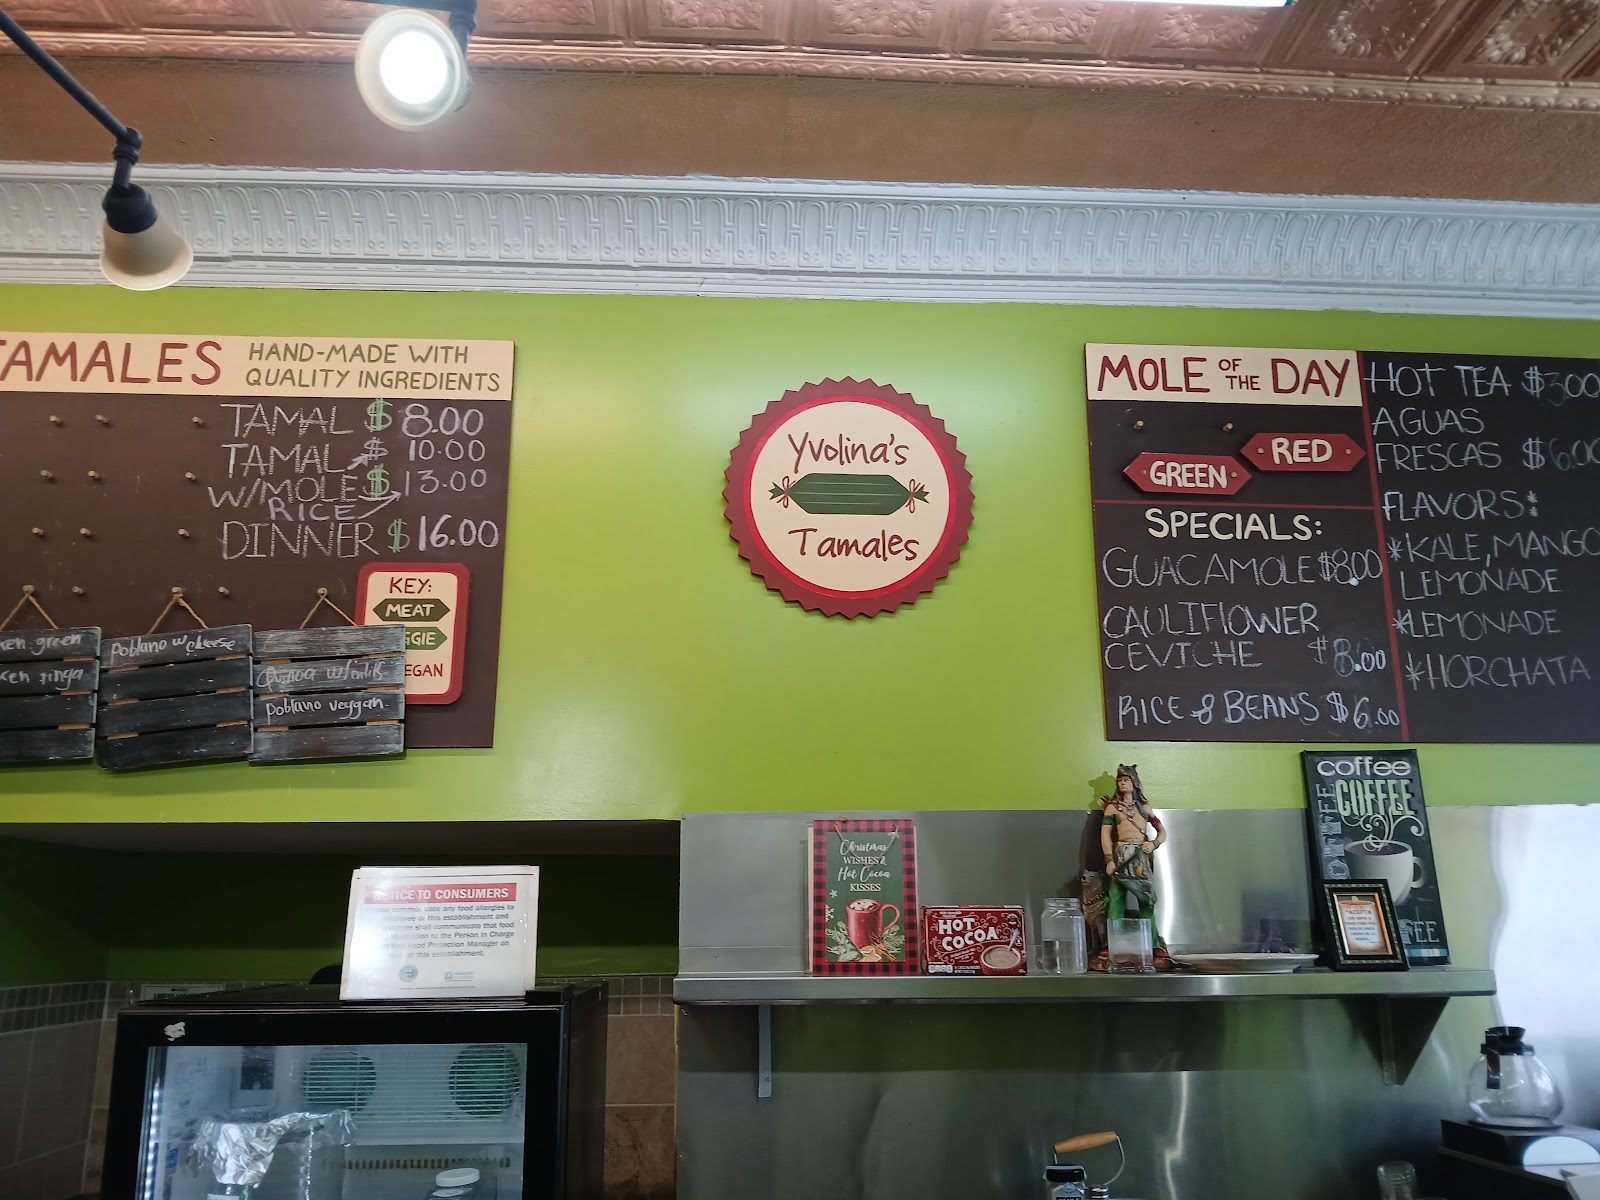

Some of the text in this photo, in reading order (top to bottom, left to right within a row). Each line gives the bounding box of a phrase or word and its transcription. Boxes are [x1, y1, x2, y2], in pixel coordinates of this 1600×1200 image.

[0, 340, 222, 385] AMALES
[249, 343, 469, 364] HAND-MADE WITH
[246, 368, 500, 392] QUALITY INGREDIENTS
[1098, 355, 1350, 397] MOLE OF THE DAY
[1363, 362, 1446, 397] HOT
[1453, 365, 1512, 397] TEA
[220, 403, 353, 438] TAMAL
[1372, 407, 1485, 437] AGUAS
[221, 443, 346, 478] TAMAL
[1271, 437, 1333, 465] RED
[1375, 441, 1503, 473] FRESCAS
[1149, 460, 1228, 488] GREEN
[268, 497, 356, 521] RICE
[1145, 508, 1323, 541] SPECIALS:
[222, 521, 380, 560] DINNER
[788, 528, 920, 561] Tamales
[389, 577, 431, 594] KEY:
[1400, 568, 1563, 600] LEMONADE
[385, 603, 435, 618] MEAT
[405, 631, 437, 646] GGIE
[1104, 639, 1263, 672] CEVICHE
[405, 663, 443, 677] EGAN
[1118, 695, 1184, 729] RICE
[1224, 690, 1320, 726] BEANS
[1317, 756, 1411, 777] coffee
[1335, 779, 1416, 817] COFFEE
[1316, 784, 1351, 880] OFFEE
[838, 866, 891, 882] Hot Cocoa
[843, 857, 880, 865] WISHES
[371, 887, 509, 900] OTICE TO CONSUMERS
[850, 883, 881, 892] KISSES
[938, 917, 976, 935] HOT
[942, 926, 1000, 951] COCOA
